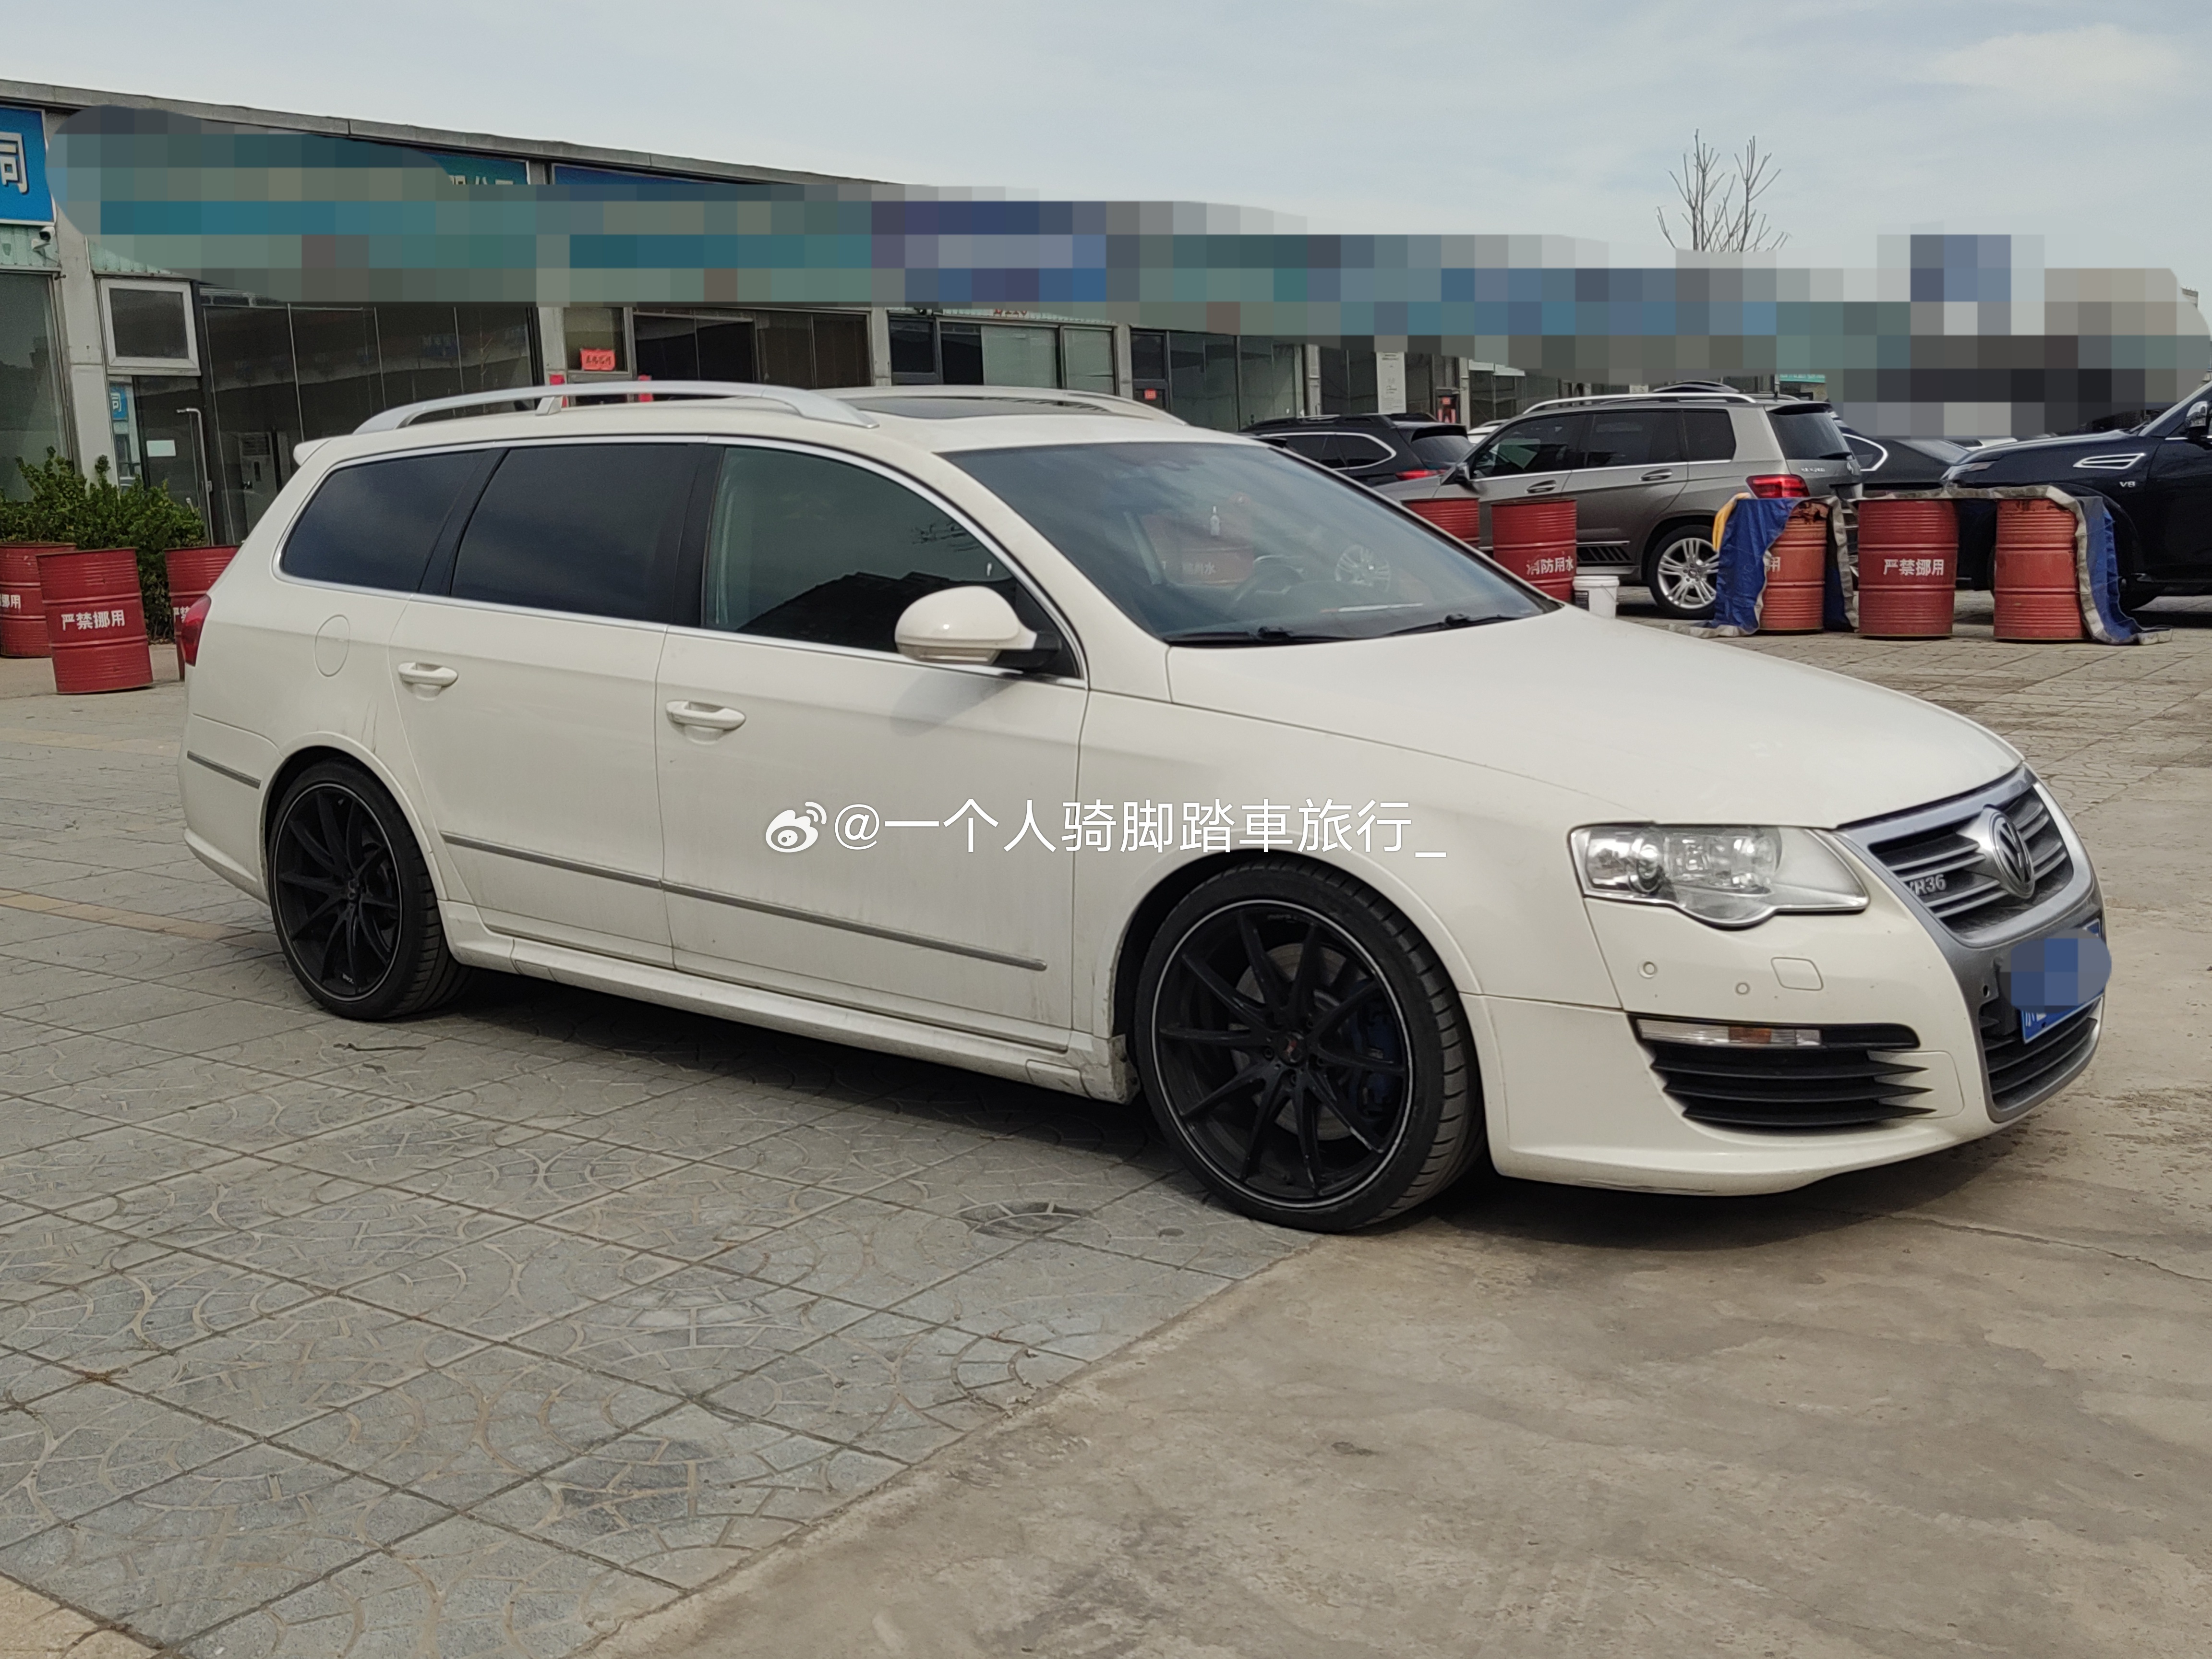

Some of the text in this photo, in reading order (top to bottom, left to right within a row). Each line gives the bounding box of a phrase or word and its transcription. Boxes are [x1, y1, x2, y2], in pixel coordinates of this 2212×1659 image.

[1883, 558, 1944, 576] 严禁挪用
[0, 593, 22, 609] 挪用
[61, 610, 125, 631] 严禁挪用
